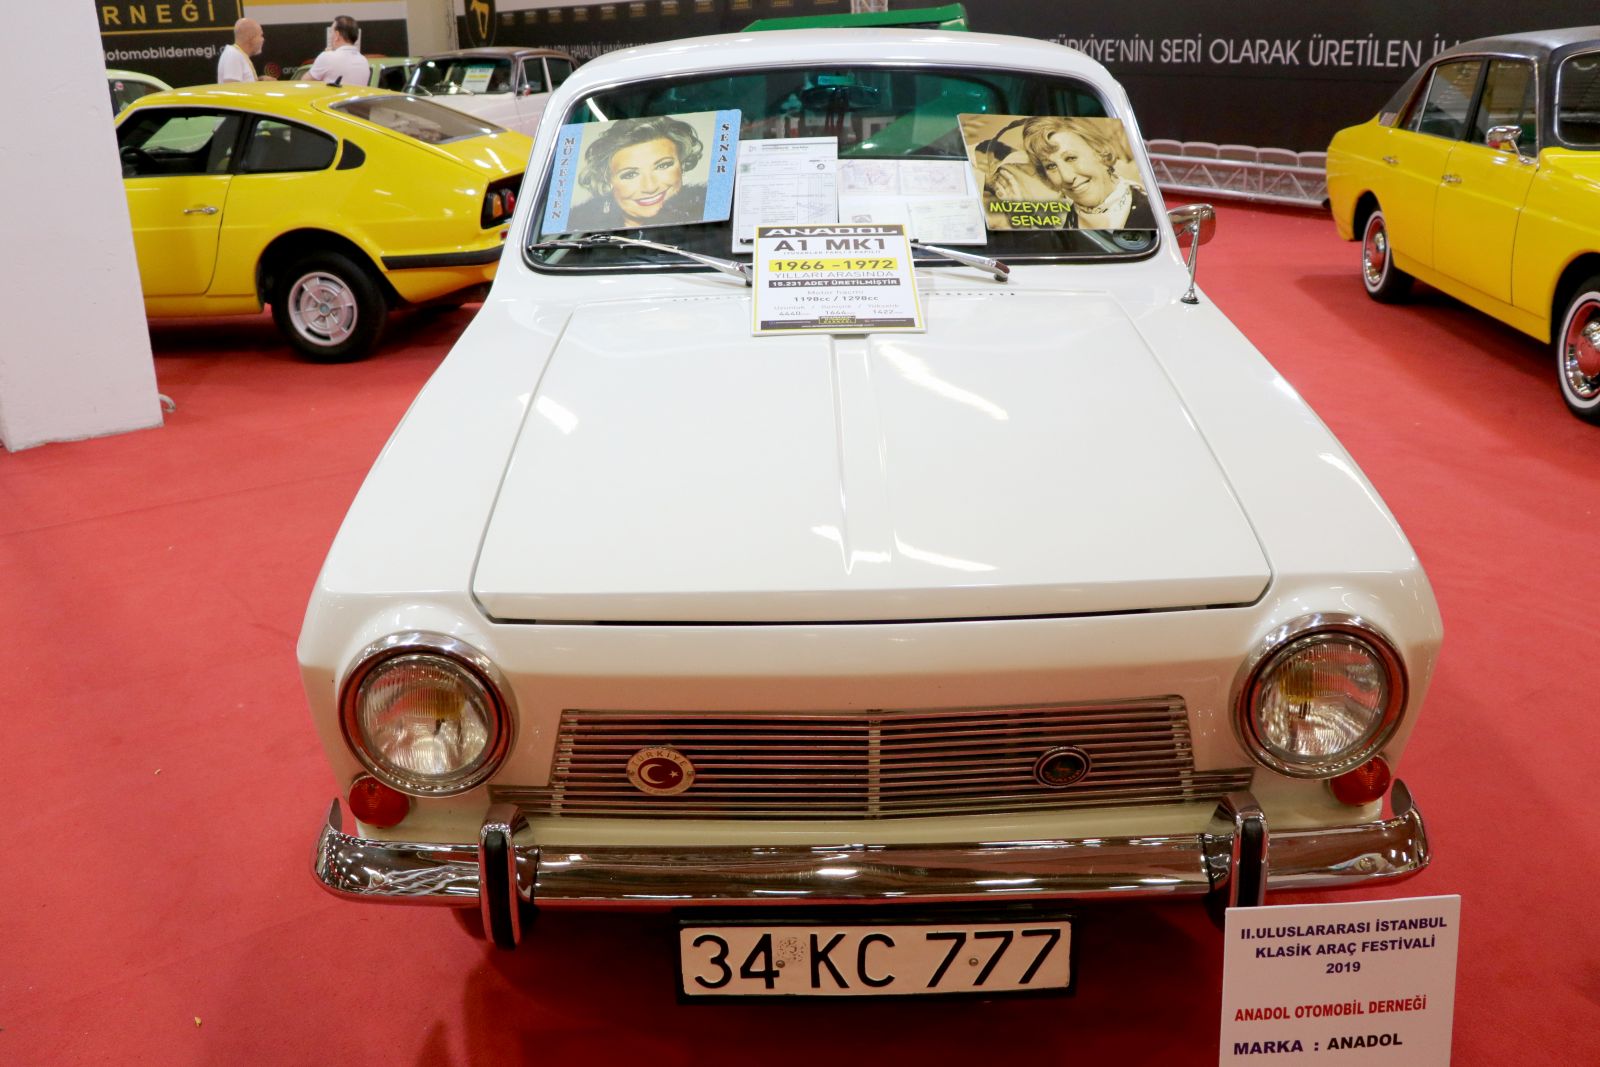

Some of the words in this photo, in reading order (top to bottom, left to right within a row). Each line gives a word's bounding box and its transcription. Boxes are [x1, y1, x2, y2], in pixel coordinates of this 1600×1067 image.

[1160, 33, 1202, 63] SERİ
[1209, 39, 1302, 65] OLARAK
[1308, 33, 1422, 67] ÜRETİLEN
[716, 123, 731, 173] SENAR
[989, 200, 1071, 213] MÜZEYYEN
[1011, 215, 1062, 226] SENAR
[765, 227, 898, 236] ANADOL
[774, 239, 808, 251] A1
[825, 238, 885, 250] MK1
[774, 261, 825, 270] 1966
[827, 270, 894, 278] ARASINDA
[1240, 922, 1371, 940] II.ULUSLARARASI
[1375, 916, 1447, 932] İSTANBUL
[1255, 943, 1312, 958] KLASİK
[1316, 942, 1357, 956] ARAÇ
[1361, 934, 1436, 952] FESTİVALİ
[692, 933, 780, 990] 34
[809, 932, 896, 989] KC
[925, 928, 1061, 988] 777
[1325, 961, 1361, 974] 2019
[1234, 1007, 1291, 1022] ANADOL
[1294, 999, 1364, 1018] OTOMOBİL
[1368, 994, 1427, 1014] DERNEĞİ
[1233, 1039, 1304, 1055] MARKA
[1327, 1032, 1403, 1051] ANADOL
